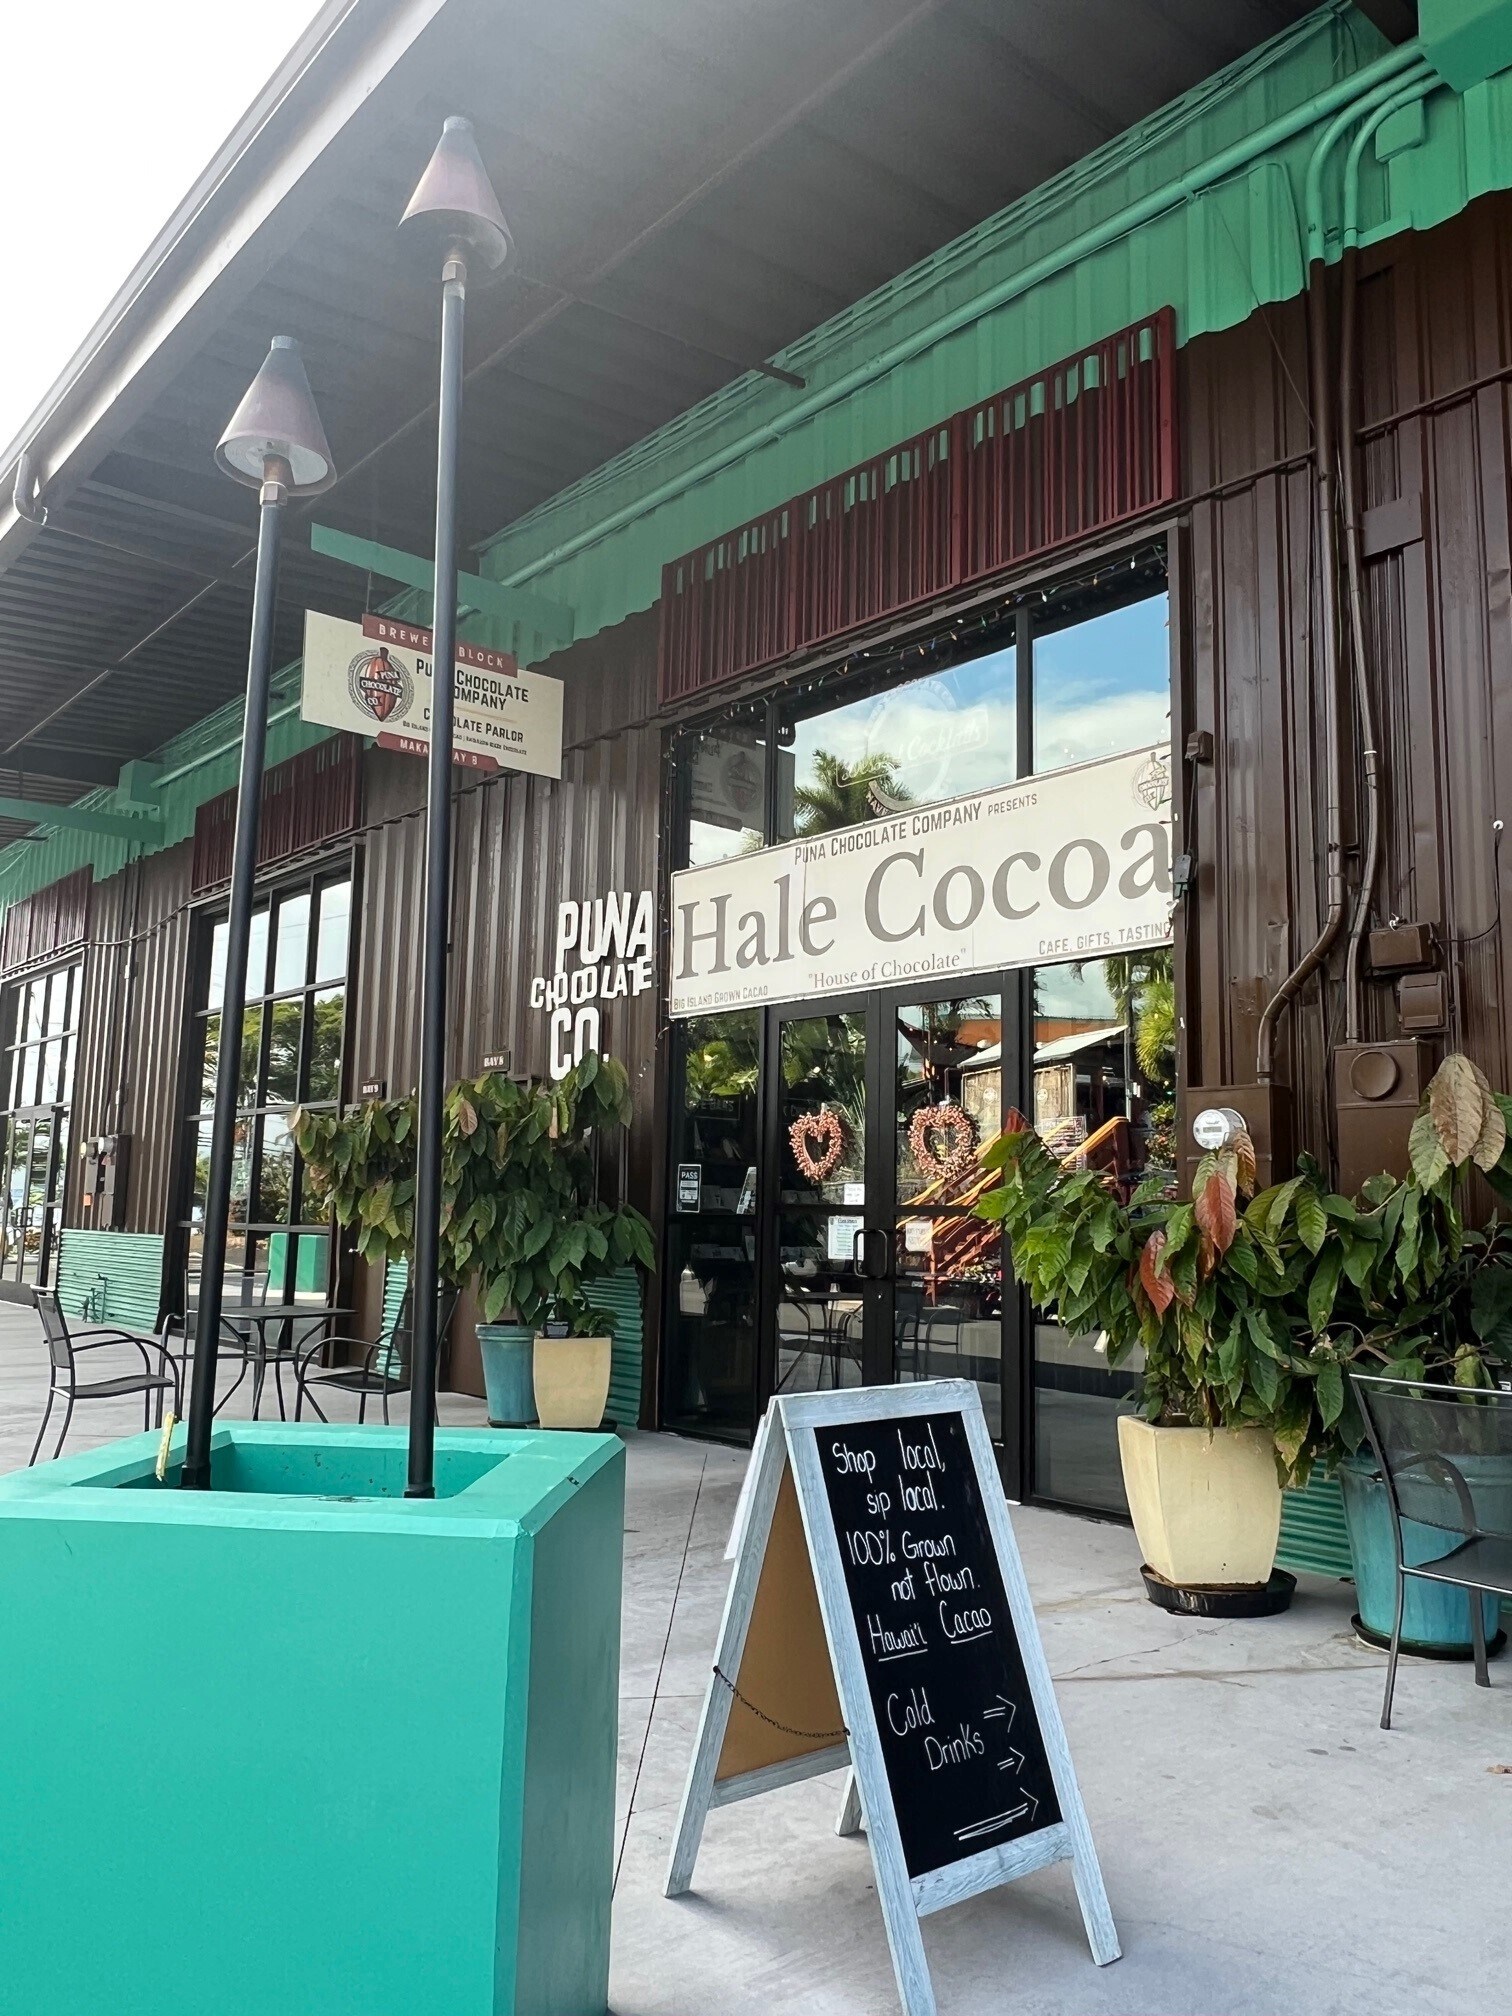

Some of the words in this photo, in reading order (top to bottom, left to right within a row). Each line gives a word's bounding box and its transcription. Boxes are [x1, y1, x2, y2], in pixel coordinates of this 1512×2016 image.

[379, 623, 429, 647] BREWE
[459, 646, 503, 668] BLOCK
[454, 685, 507, 711] OMPANY
[456, 669, 529, 702] CHOCOLATE
[400, 739, 429, 755] MAKA
[485, 722, 524, 743] PARLOR
[795, 843, 826, 865] PUNA
[831, 821, 907, 857] CHOCOLATE
[912, 801, 981, 836] COMPANY
[988, 793, 1037, 816] PRESENTS
[676, 873, 837, 980] Hale
[864, 822, 1172, 943] Cocoa
[555, 890, 653, 974] PUNA
[861, 963, 878, 981] of
[881, 947, 967, 978] Chocolate"
[530, 955, 652, 1012] CHOCOLATE
[673, 998, 685, 1010] BIG
[687, 994, 712, 1008] ISLAND
[714, 989, 741, 1004] GROWN
[742, 985, 768, 1000] CACAO
[681, 1171, 698, 1180] PASS
[832, 1442, 876, 1483] Shop
[897, 1423, 946, 1472] local,
[867, 1489, 891, 1520] sip
[897, 1470, 946, 1512] local.
[846, 1529, 896, 1567] 100%
[902, 1530, 956, 1560] Grown
[891, 1572, 914, 1602] not
[939, 1600, 992, 1639] Cacao
[887, 1687, 935, 1737] Cold
